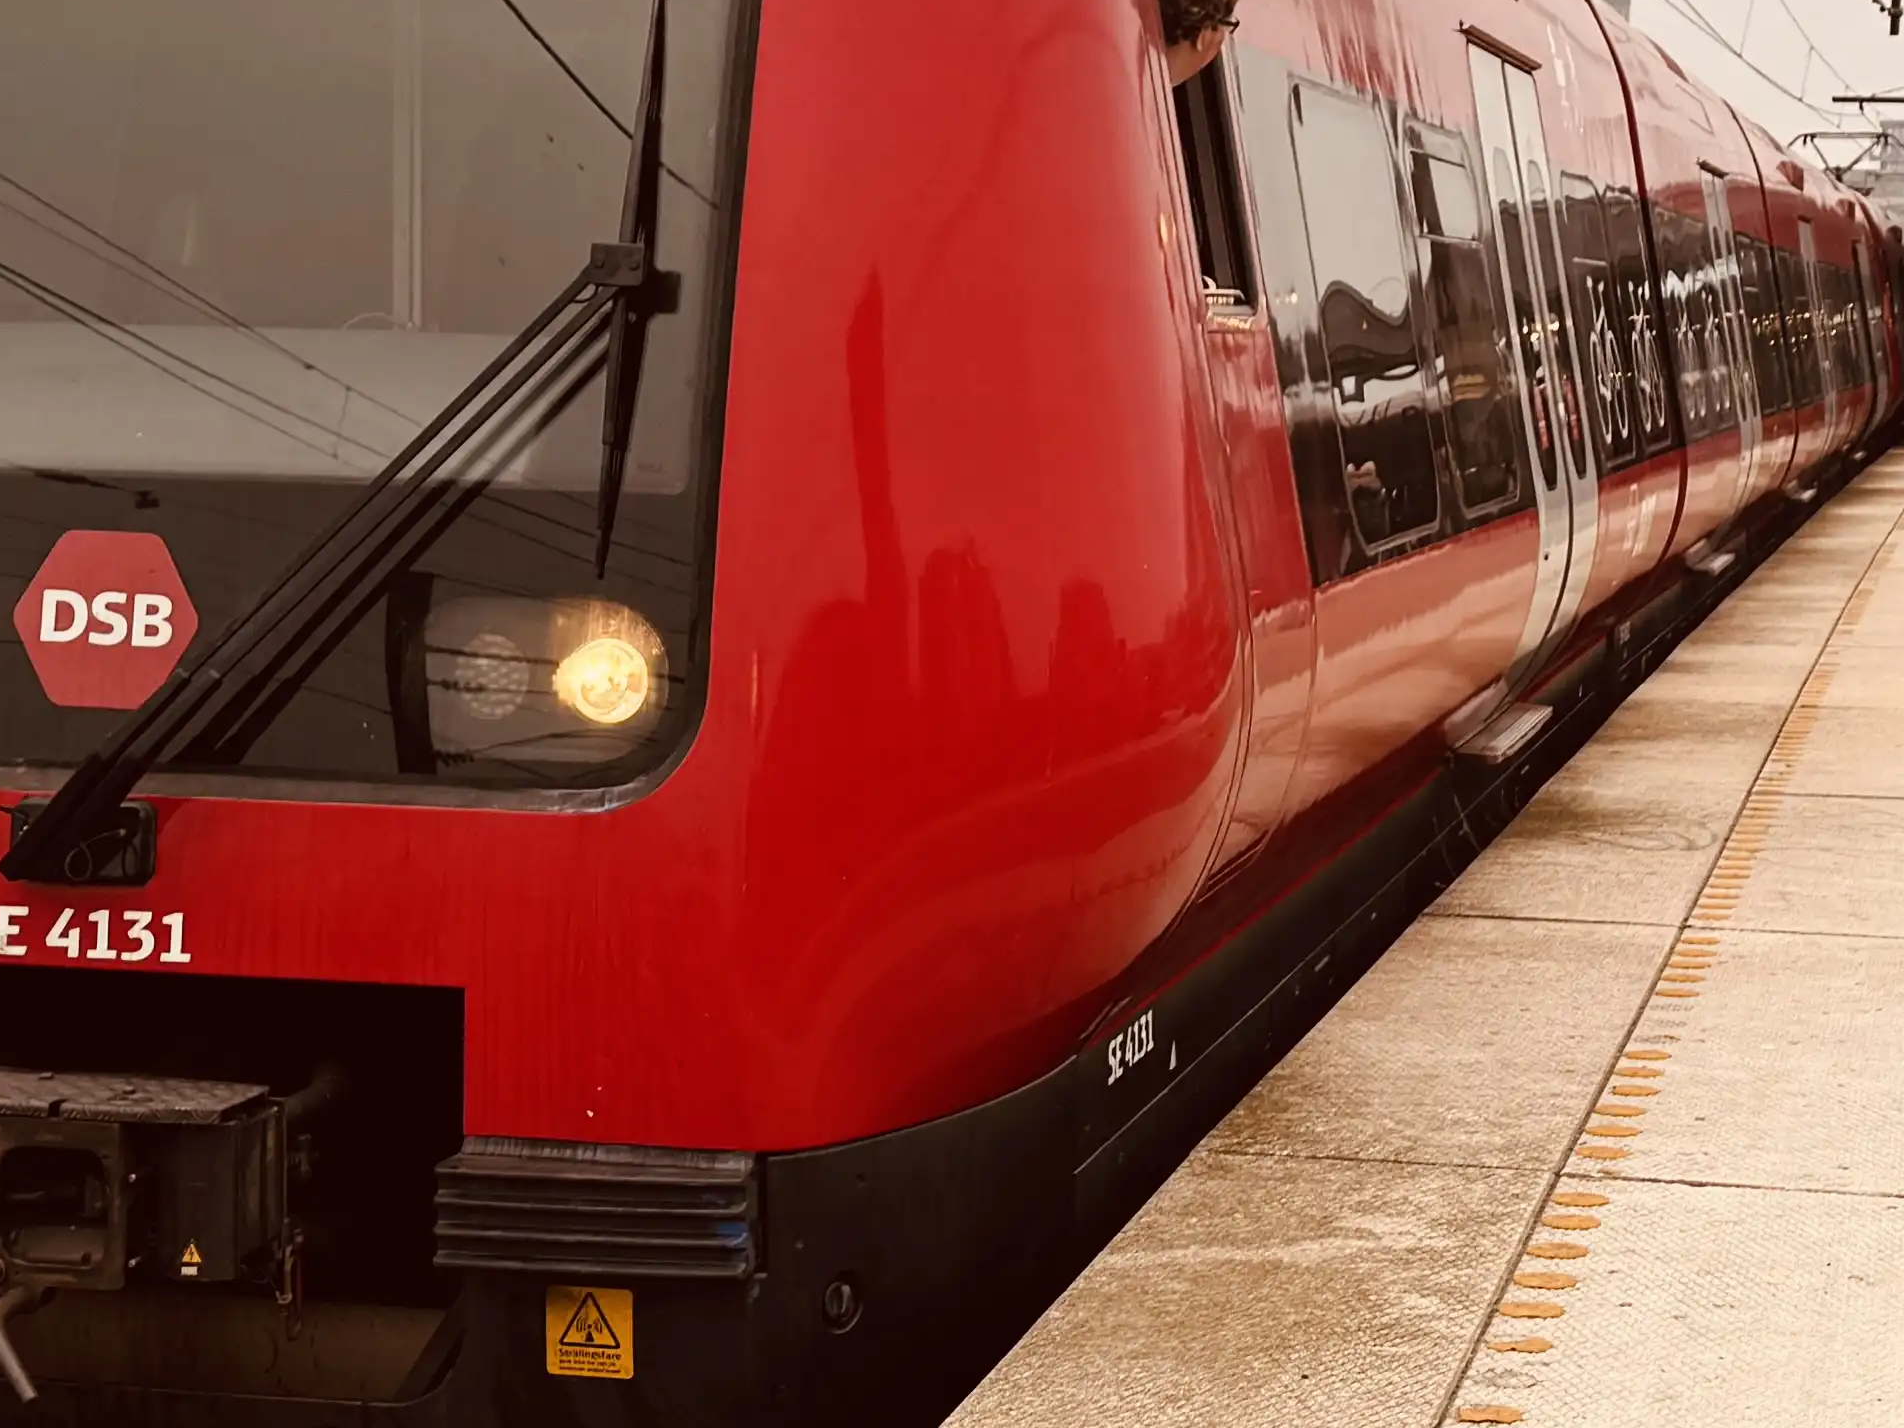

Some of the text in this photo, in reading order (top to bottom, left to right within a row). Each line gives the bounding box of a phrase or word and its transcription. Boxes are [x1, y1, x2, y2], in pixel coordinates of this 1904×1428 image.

[40, 589, 173, 648] DSB
[45, 907, 191, 964] 4131
[1107, 1008, 1154, 1086] SE 4131
